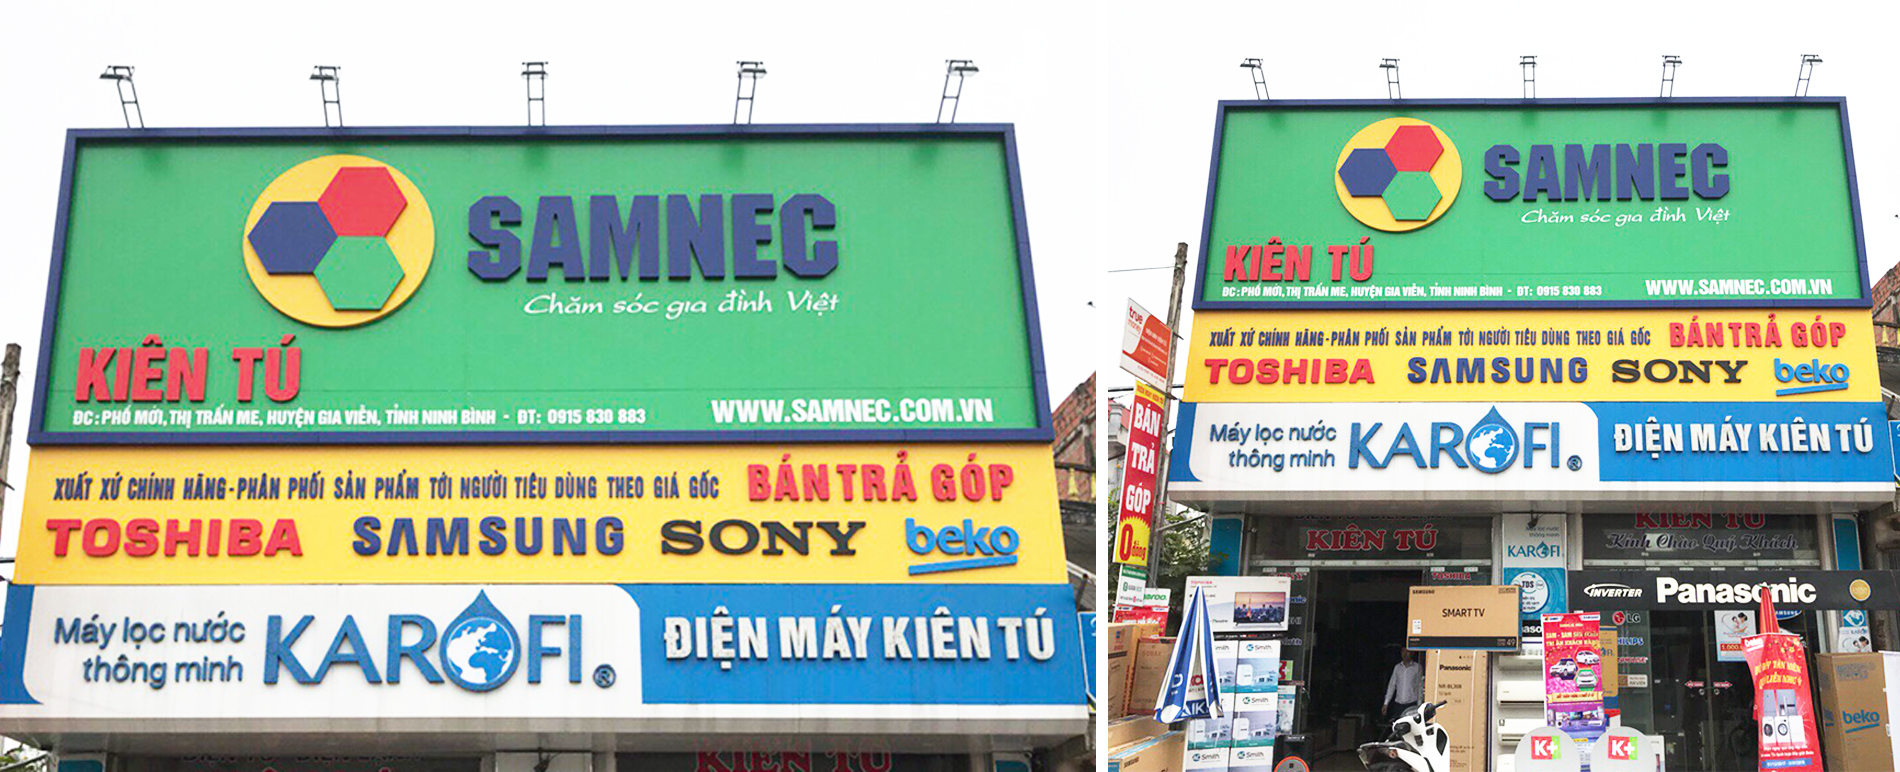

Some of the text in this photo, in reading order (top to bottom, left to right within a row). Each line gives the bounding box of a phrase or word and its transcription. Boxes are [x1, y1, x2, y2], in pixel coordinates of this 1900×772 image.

[1483, 143, 1730, 202] SAMNEC
[1521, 208, 1574, 223] Chăm
[1580, 209, 1611, 222] sóc
[1650, 207, 1686, 222] đình
[1696, 207, 1731, 224] Việt
[467, 193, 839, 283] SAMNEC
[1223, 236, 1374, 282] KIÊN TÚ
[1241, 281, 1261, 297] PHỐ
[1304, 281, 1329, 297] TRẤN
[1331, 286, 1348, 298] ME,
[1351, 284, 1382, 298] HUYỆN
[1385, 286, 1400, 296] GIA
[1454, 286, 1478, 297] NINH
[1480, 284, 1503, 297] BÌNH
[1517, 286, 1533, 297] ĐT:
[1536, 286, 1560, 297] 0915
[1562, 286, 1581, 297] 830
[1583, 286, 1602, 297] 883
[1645, 278, 1833, 296] WWW.SAMNEC.COM.VN
[523, 293, 604, 314] Chăm
[613, 292, 659, 314] sóc
[717, 289, 773, 313] đình
[787, 290, 840, 317] Việt
[1129, 306, 1143, 325] true
[1208, 327, 1236, 346] XUẤT
[1239, 327, 1256, 346] XỨ
[1258, 328, 1291, 346] CHÍNH
[1364, 327, 1391, 346] PHỐI
[1395, 326, 1417, 346] SẢN
[1421, 326, 1452, 346] PHẨM
[1458, 327, 1475, 346] TỚI
[1479, 326, 1511, 346] NGƯỜI
[1515, 326, 1537, 346] TIÊU
[1542, 327, 1570, 346] DÙNG
[1576, 330, 1601, 346] THEO
[1607, 327, 1625, 346] GIÁ
[1630, 326, 1652, 346] GỐC
[1670, 313, 1847, 348] BÁN TRẢ GÓP
[74, 334, 302, 403] KIÊN TÚ
[1205, 358, 1375, 384] TOSHIBA
[1407, 356, 1588, 384] SAMSUNG
[1612, 359, 1748, 384] SONY
[1774, 358, 1850, 384] beko
[101, 404, 132, 426] PHỐ
[169, 410, 192, 429] THỊ
[195, 403, 234, 426] TRẤN
[236, 410, 264, 427] ME,
[267, 407, 315, 429] HUYỆN
[318, 410, 342, 425] GIA
[386, 403, 419, 425] TỈNH
[422, 409, 458, 425] NINH
[461, 406, 497, 425] BÌNH
[517, 409, 541, 425] ĐT:
[547, 409, 582, 425] 0915
[586, 408, 614, 425] 830
[618, 408, 646, 425] 883
[711, 398, 994, 425] WWW.SAMNEC.COM.VN
[1134, 402, 1161, 438] BÁN
[1210, 420, 1337, 446] Máy lọc nước
[1348, 405, 1561, 475] KAROFI
[1614, 416, 1874, 459] ĐIỆN MÁY KIÊN TÚ
[1131, 442, 1155, 475] TRẢ
[1229, 449, 1336, 473] thông minh
[53, 471, 93, 500] XUẤT
[99, 471, 123, 500] XỨ
[127, 472, 175, 500] CHÍNH
[288, 471, 324, 500] PHỐI
[333, 470, 366, 500] SẢN
[374, 469, 419, 500] PHẨM
[429, 472, 452, 500] TỚI
[460, 470, 507, 500] NGƯỜI
[514, 472, 547, 500] TIÊU
[555, 472, 597, 500] DÙNG
[607, 476, 644, 500] THEO
[653, 472, 680, 500] GIÁ
[689, 470, 719, 500] GỐC
[747, 450, 1015, 502] BÁN TRẢ GÓP
[1125, 482, 1151, 514] GÓP
[46, 518, 303, 557] TOSHIBA
[352, 516, 625, 557] SAMSUNG
[661, 520, 866, 557] SONY
[905, 518, 1020, 557] beko
[1120, 523, 1133, 561] 0
[1306, 523, 1438, 551] KIÊN TÚ
[1507, 541, 1560, 558] KAROFI
[1606, 533, 1798, 552] Kính Chào Quý Khách
[1432, 572, 1471, 580] TOSHIBA
[1590, 586, 1643, 597] INVERTER
[1442, 608, 1485, 617] SMART TV
[1626, 611, 1641, 623] LG
[54, 614, 246, 649] Máy lọc nước
[263, 589, 584, 692] KAROFI
[664, 605, 1055, 670] ĐIỆN MÁY KIÊN TÚ
[83, 655, 243, 689] thông minh
[1842, 709, 1880, 724] beko
[1535, 740, 1558, 756] K+
[1611, 740, 1636, 756] K+
